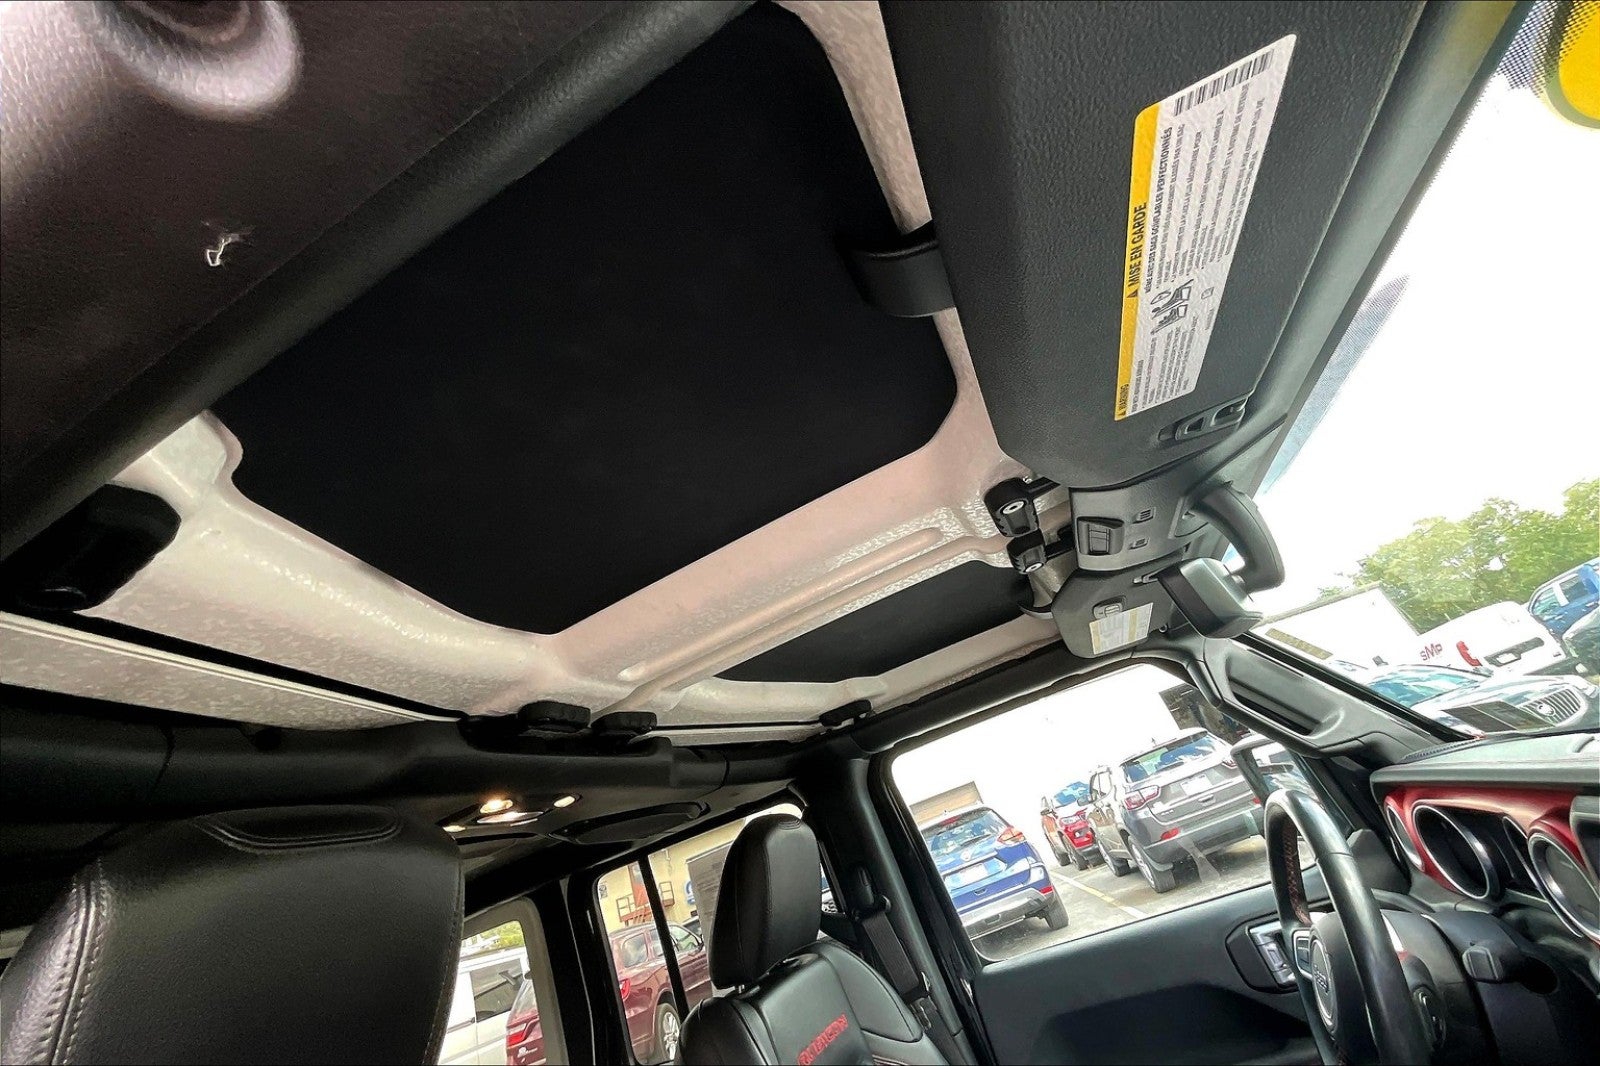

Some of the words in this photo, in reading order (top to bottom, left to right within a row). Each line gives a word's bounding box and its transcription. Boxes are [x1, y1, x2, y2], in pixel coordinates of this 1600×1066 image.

[1156, 127, 1173, 192] PERFECTIONNÉS
[1132, 203, 1147, 245] GARDE
[1152, 191, 1164, 235] GONFLABLES
[1128, 261, 1141, 287] MISE
[1131, 245, 1142, 261] EN
